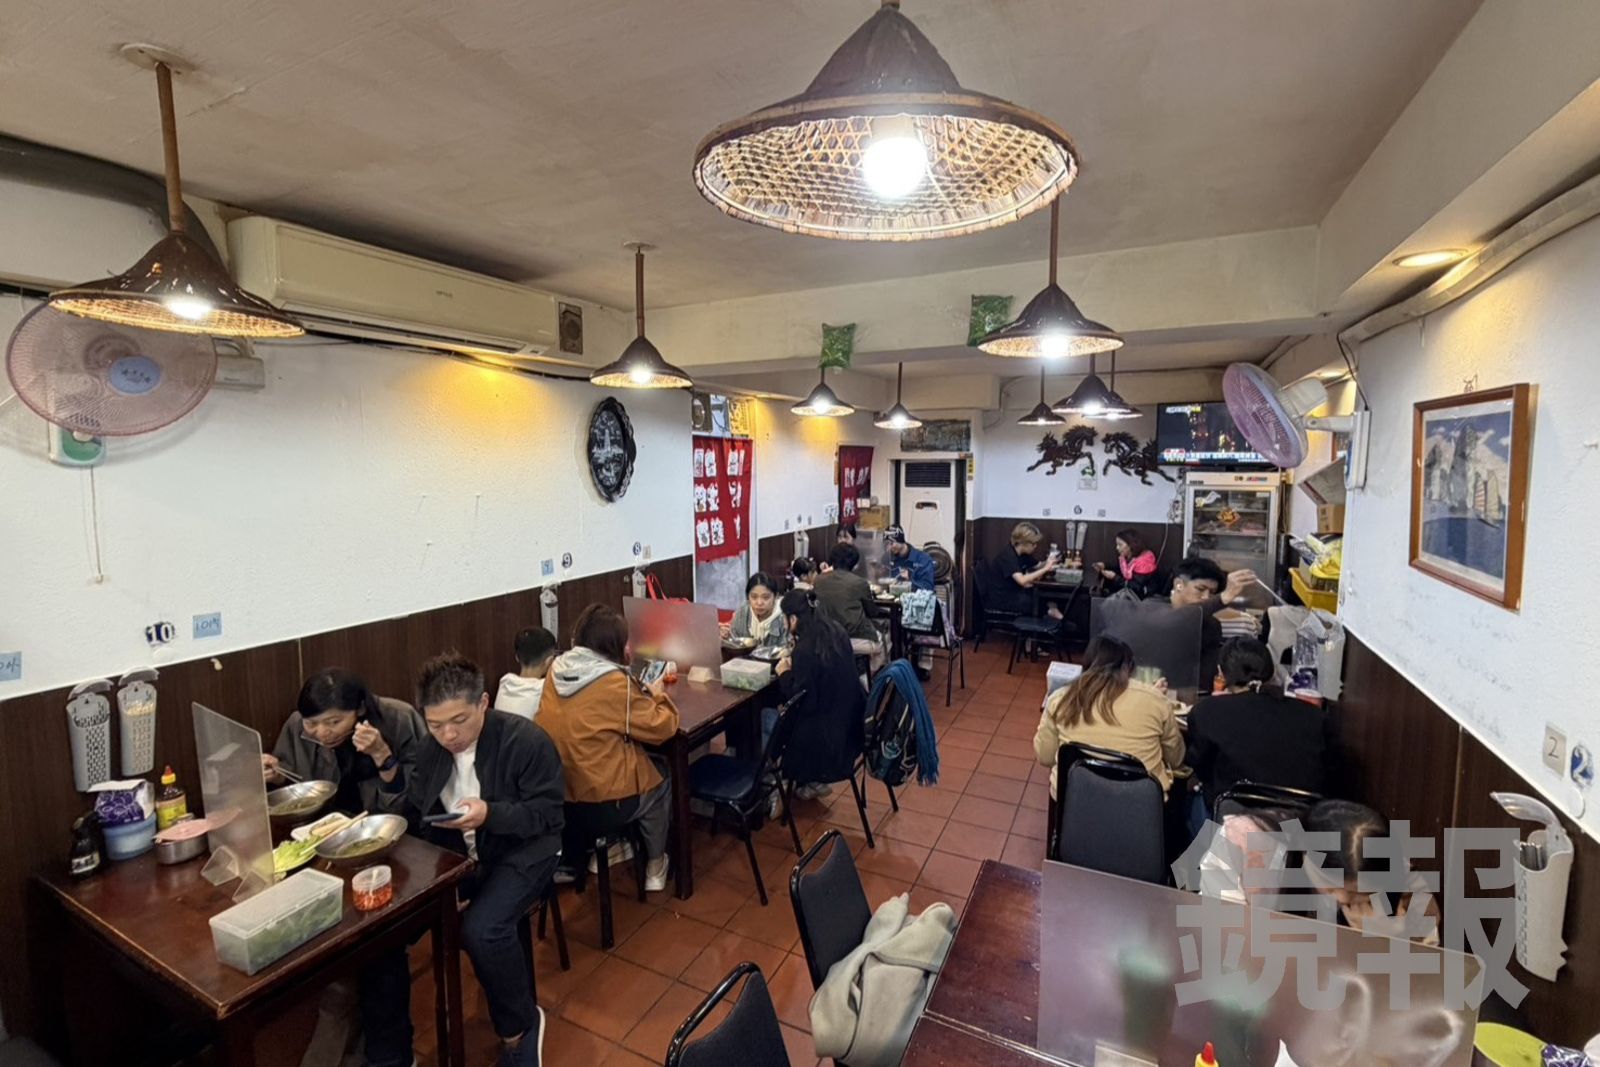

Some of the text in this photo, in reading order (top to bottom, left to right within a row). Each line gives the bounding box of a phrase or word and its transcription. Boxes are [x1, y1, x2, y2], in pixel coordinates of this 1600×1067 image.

[146, 622, 174, 646] 10
[1548, 736, 1560, 759] 2
[1572, 744, 1594, 788] 2
